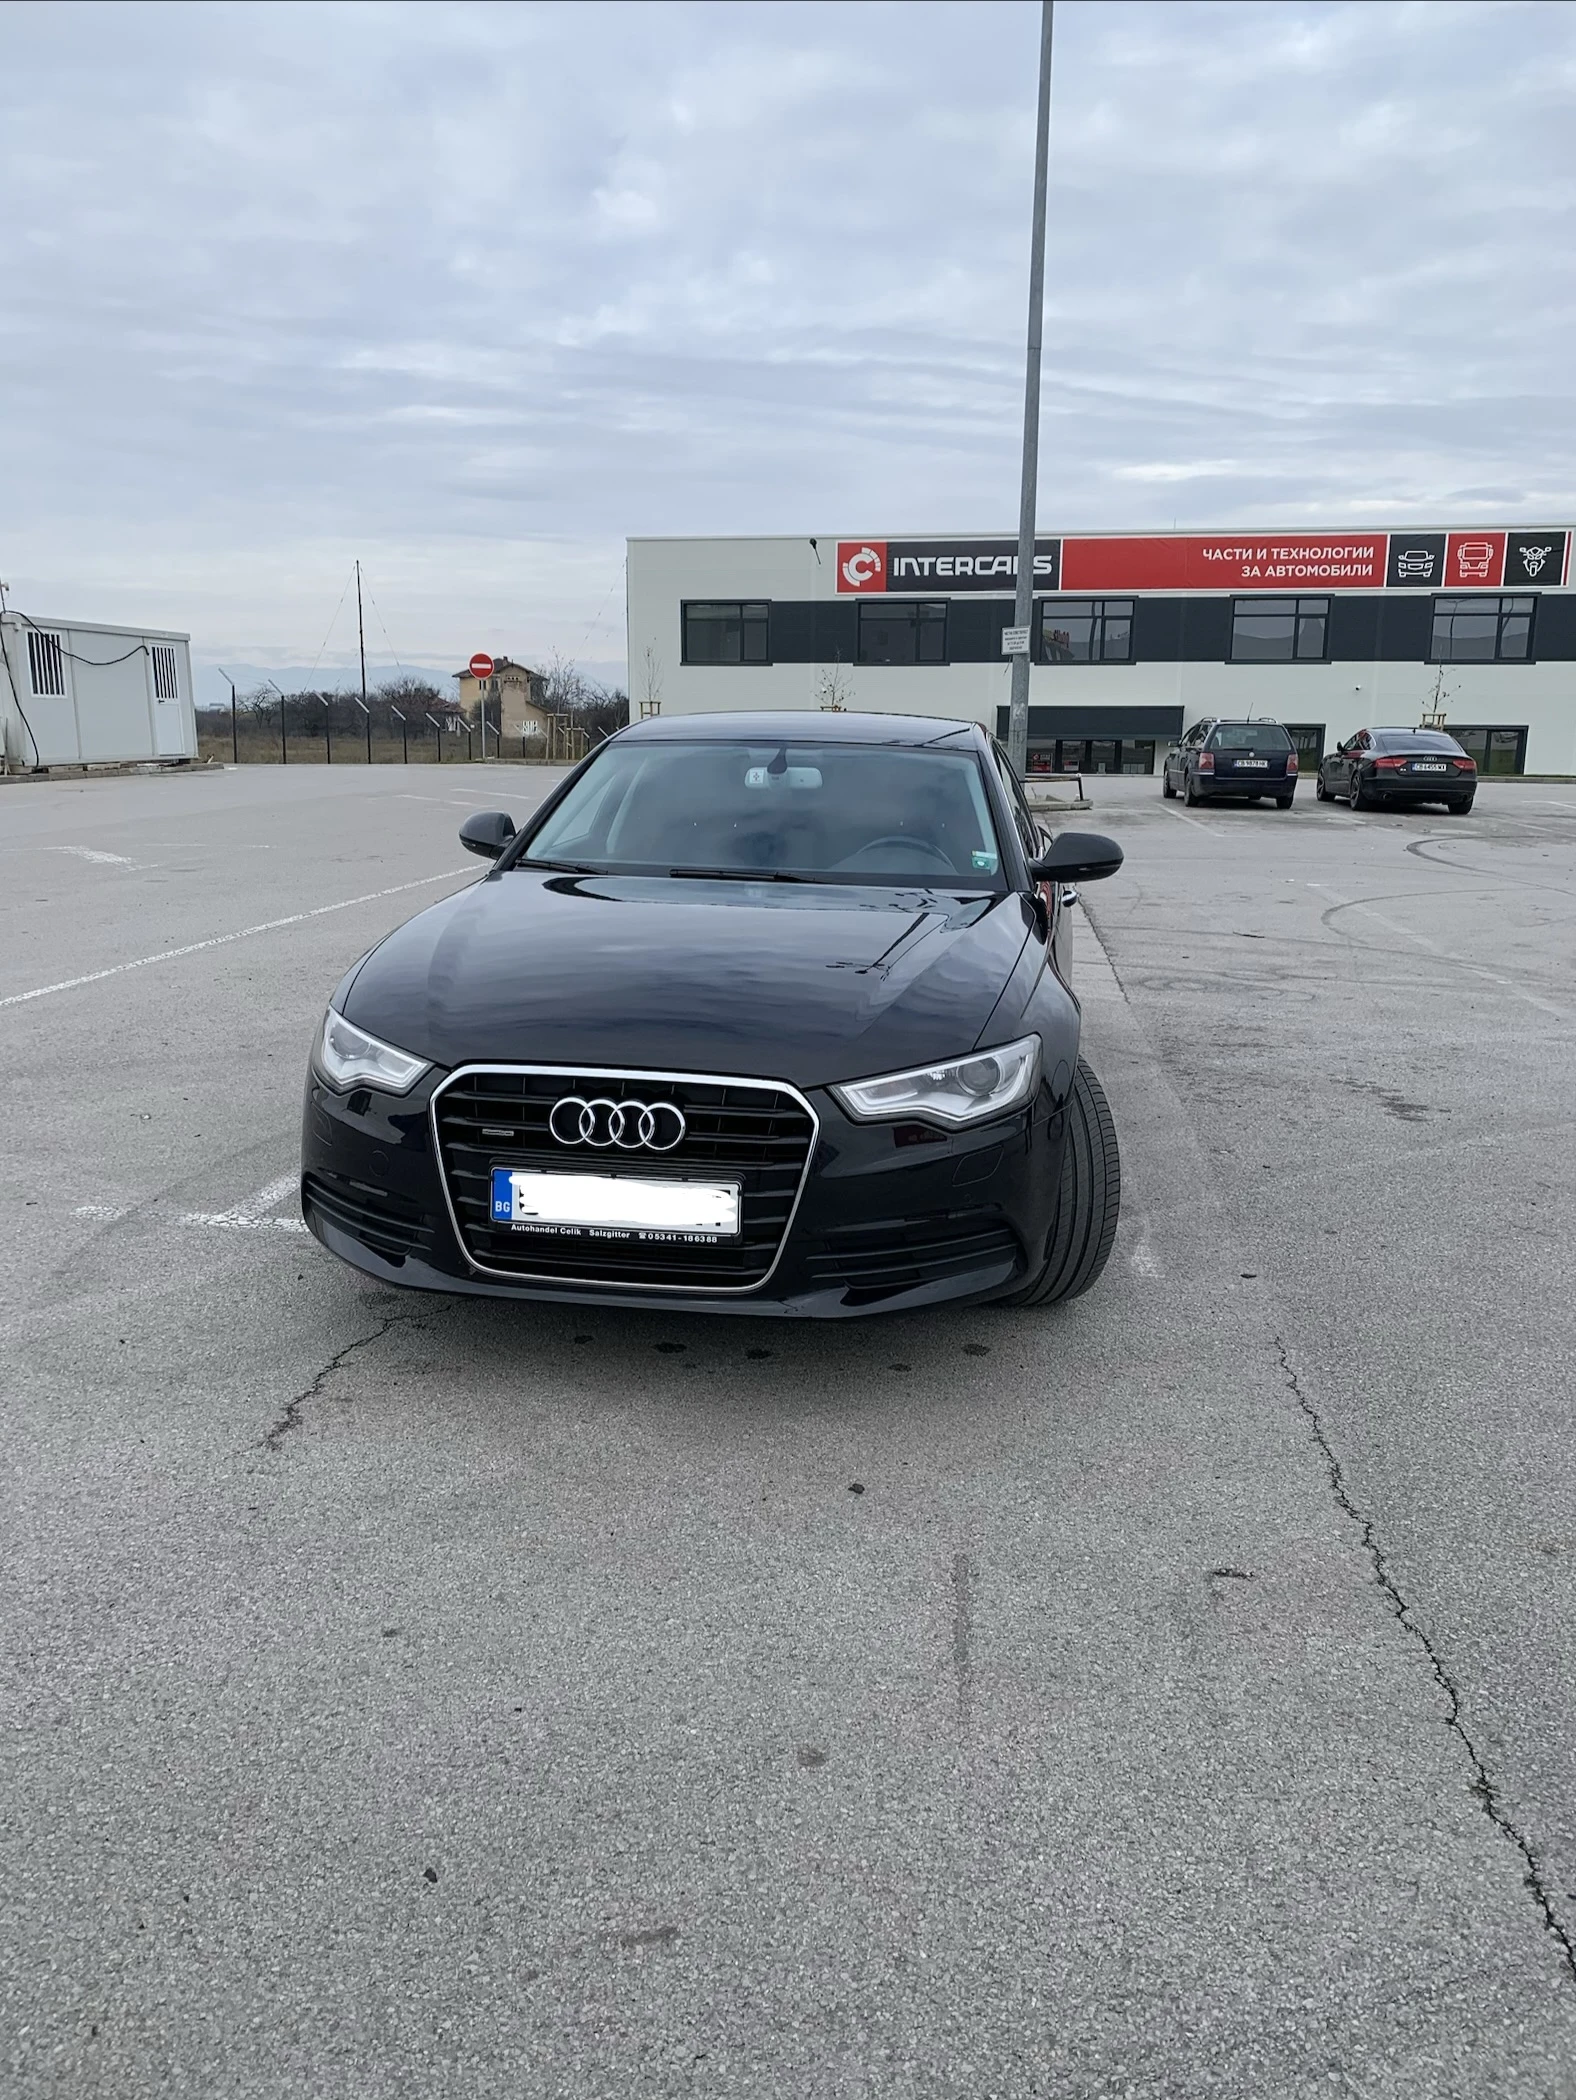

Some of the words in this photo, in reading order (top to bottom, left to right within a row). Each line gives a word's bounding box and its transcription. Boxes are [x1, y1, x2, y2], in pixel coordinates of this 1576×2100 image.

[1202, 548, 1252, 560] ЧАСТИ
[1256, 548, 1267, 560] И
[1271, 547, 1374, 560] ТЕХНОЛОГИИ
[1241, 565, 1261, 577] ЗА
[1265, 564, 1373, 577] АВТОМОБИЛИ
[495, 1201, 511, 1213] BG
[511, 1223, 558, 1234] Autohandel
[560, 1227, 582, 1236] Celik
[589, 1229, 631, 1239] Salzgitter
